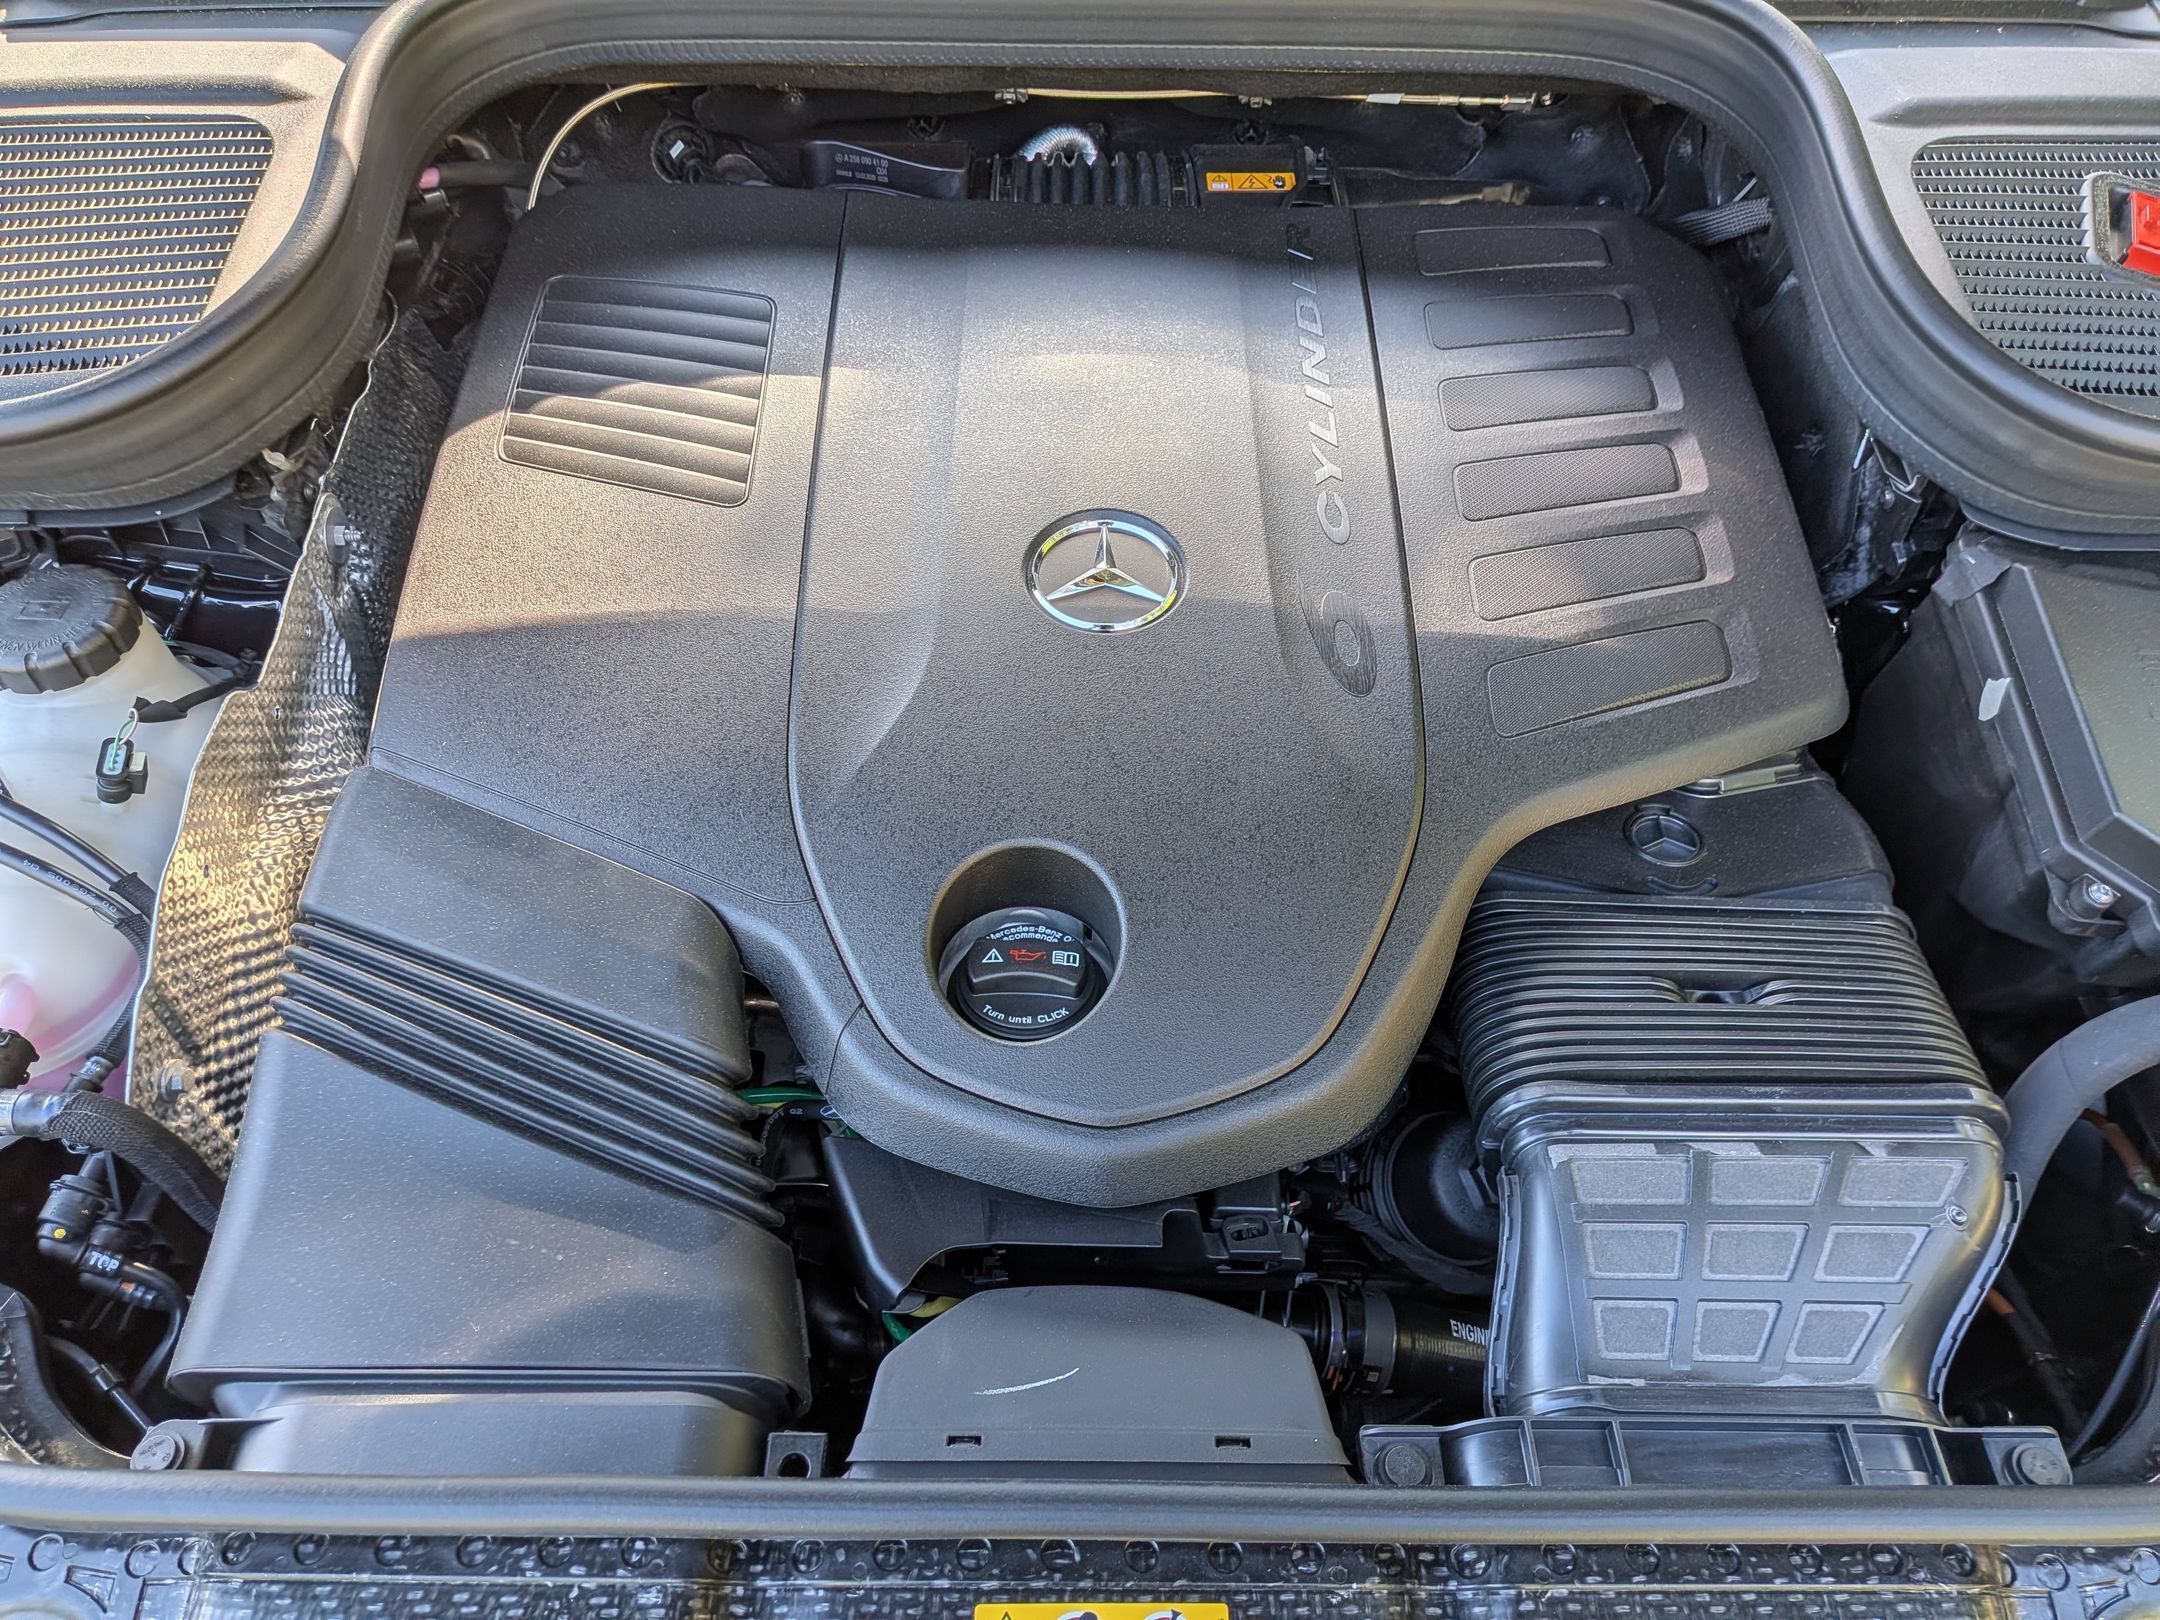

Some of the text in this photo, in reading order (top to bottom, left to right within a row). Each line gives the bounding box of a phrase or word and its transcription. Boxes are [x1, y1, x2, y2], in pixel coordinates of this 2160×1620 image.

[1285, 222, 1378, 698] 6 CYLINDER
[1002, 931, 1059, 943] ecommende
[1063, 935, 1076, 943] O
[982, 1004, 1070, 1025] Turn until CLICK
[89, 1250, 120, 1272] TOP
